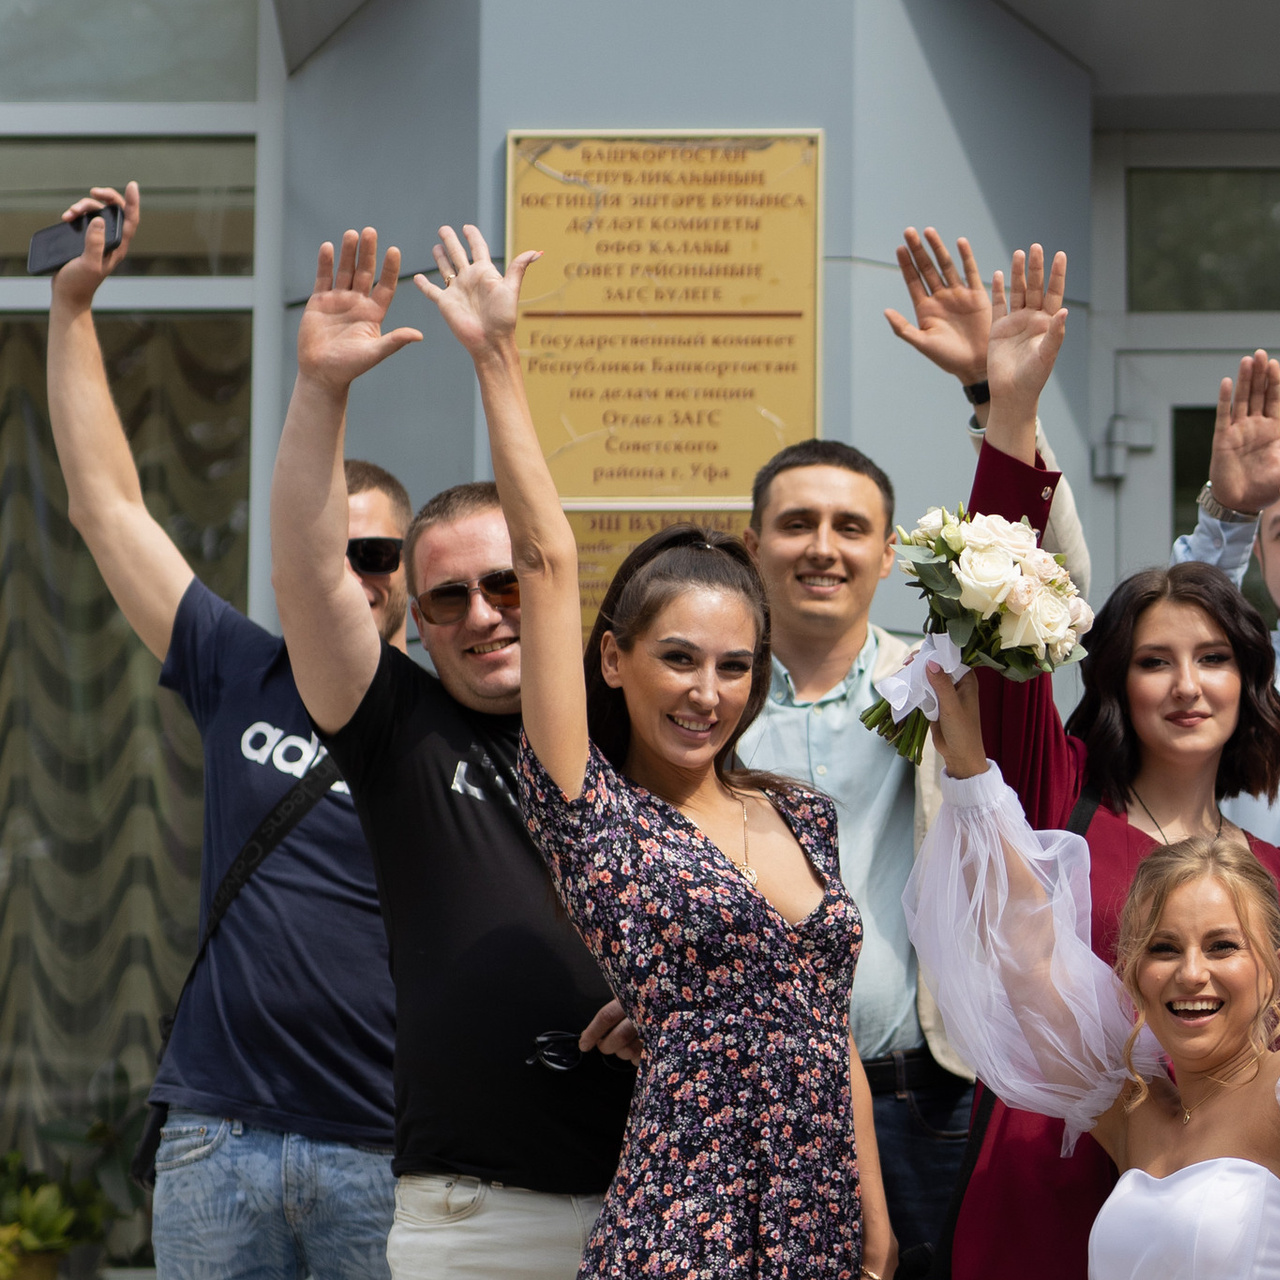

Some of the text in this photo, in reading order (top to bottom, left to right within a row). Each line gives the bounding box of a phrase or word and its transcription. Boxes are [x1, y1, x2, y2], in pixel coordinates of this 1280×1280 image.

[711, 335, 796, 347] комитет
[527, 357, 798, 378] Республики Башкортостан
[568, 388, 756, 402] по делам юстиции
[602, 410, 722, 427] Отдел ЗАГС
[604, 437, 719, 455] Советского
[592, 464, 666, 485] района
[689, 463, 731, 484] Уфа
